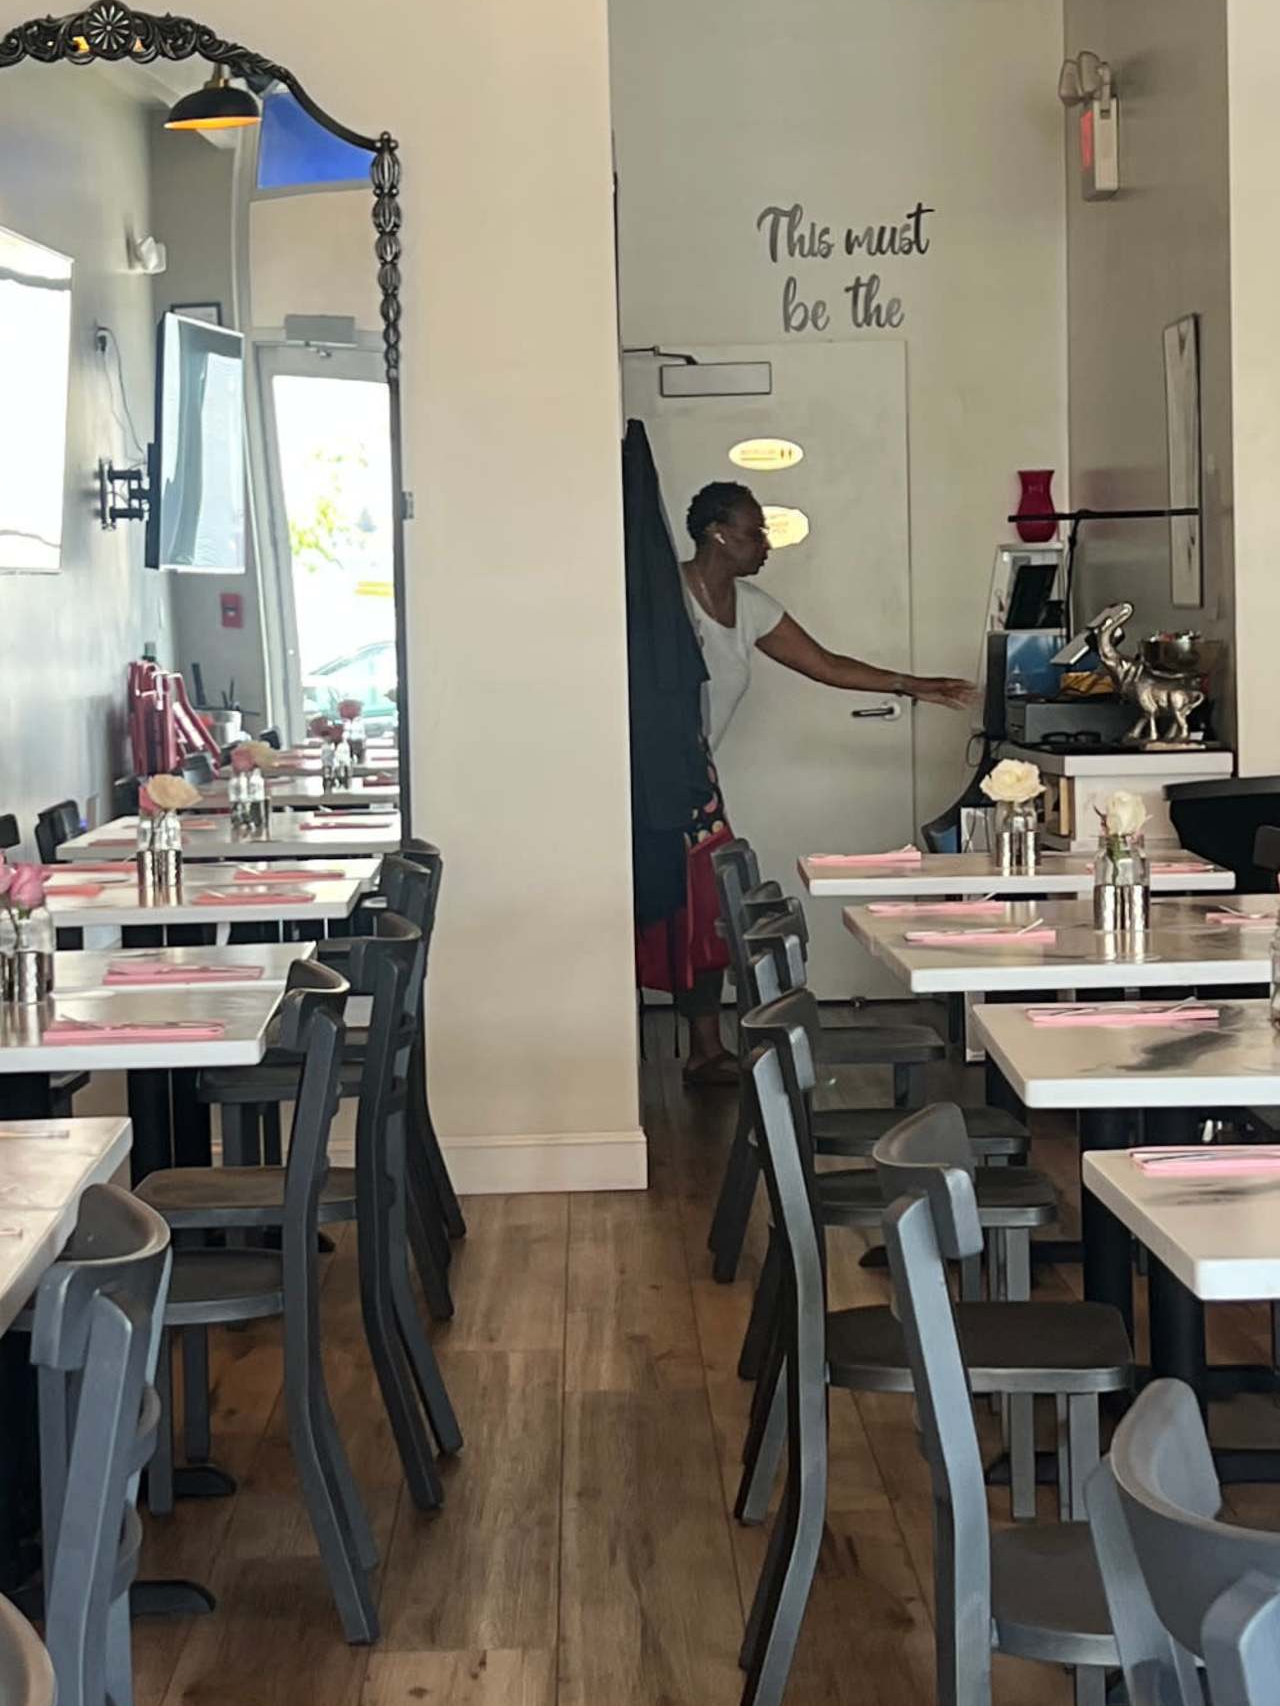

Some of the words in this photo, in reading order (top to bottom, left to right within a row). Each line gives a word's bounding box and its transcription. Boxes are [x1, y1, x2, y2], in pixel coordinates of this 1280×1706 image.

[756, 203, 835, 263] This
[845, 202, 935, 256] must
[782, 276, 830, 333] be
[844, 274, 905, 328] the
